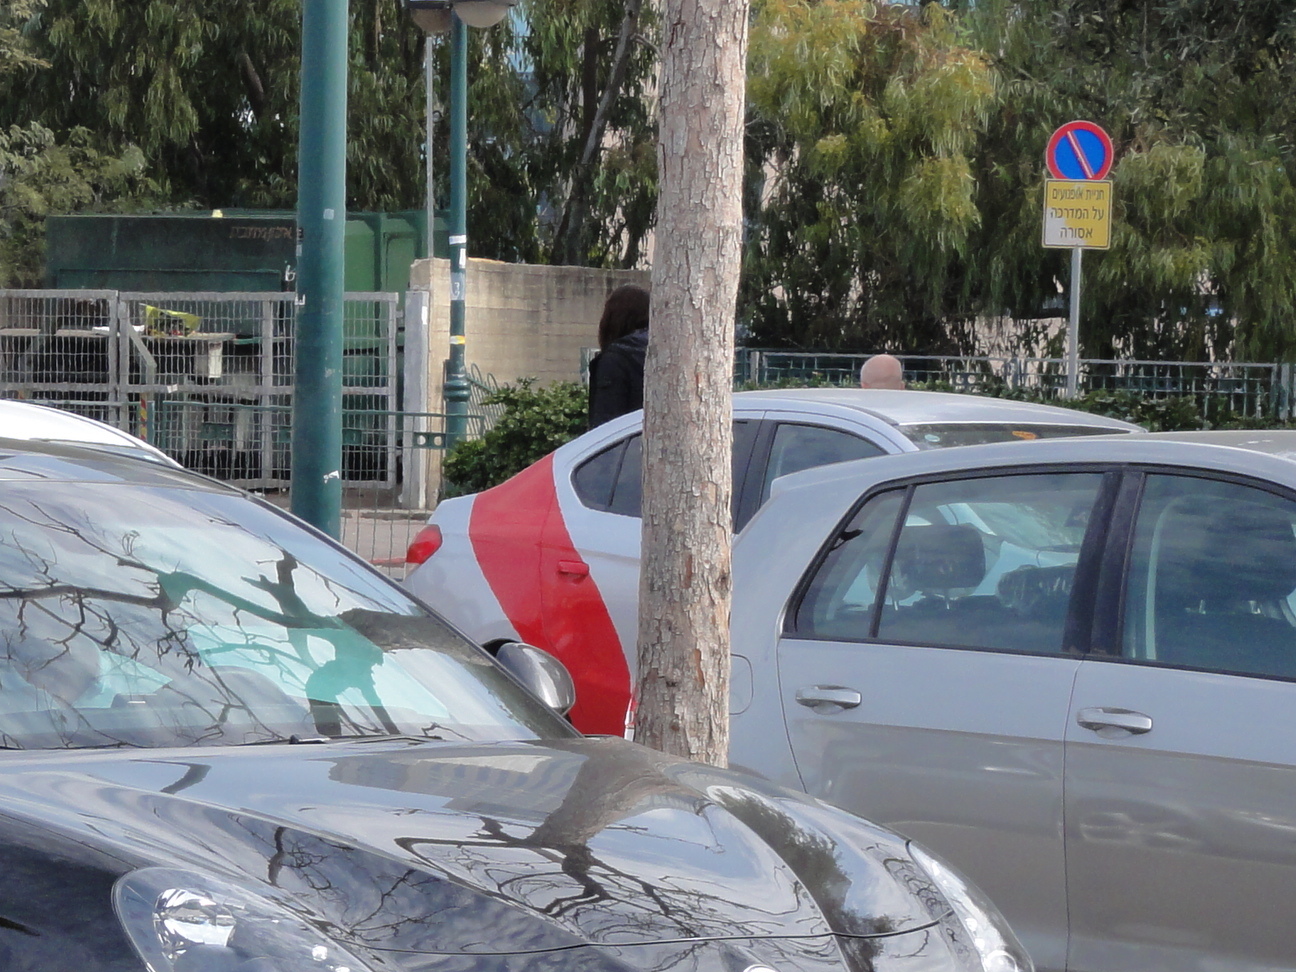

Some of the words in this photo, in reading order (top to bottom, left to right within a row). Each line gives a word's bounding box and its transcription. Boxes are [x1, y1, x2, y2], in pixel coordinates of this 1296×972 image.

[1085, 189, 1105, 201] חניית
[1050, 207, 1089, 220] המדרכה
[1091, 206, 1105, 221] על
[1060, 227, 1093, 239] אסורה
